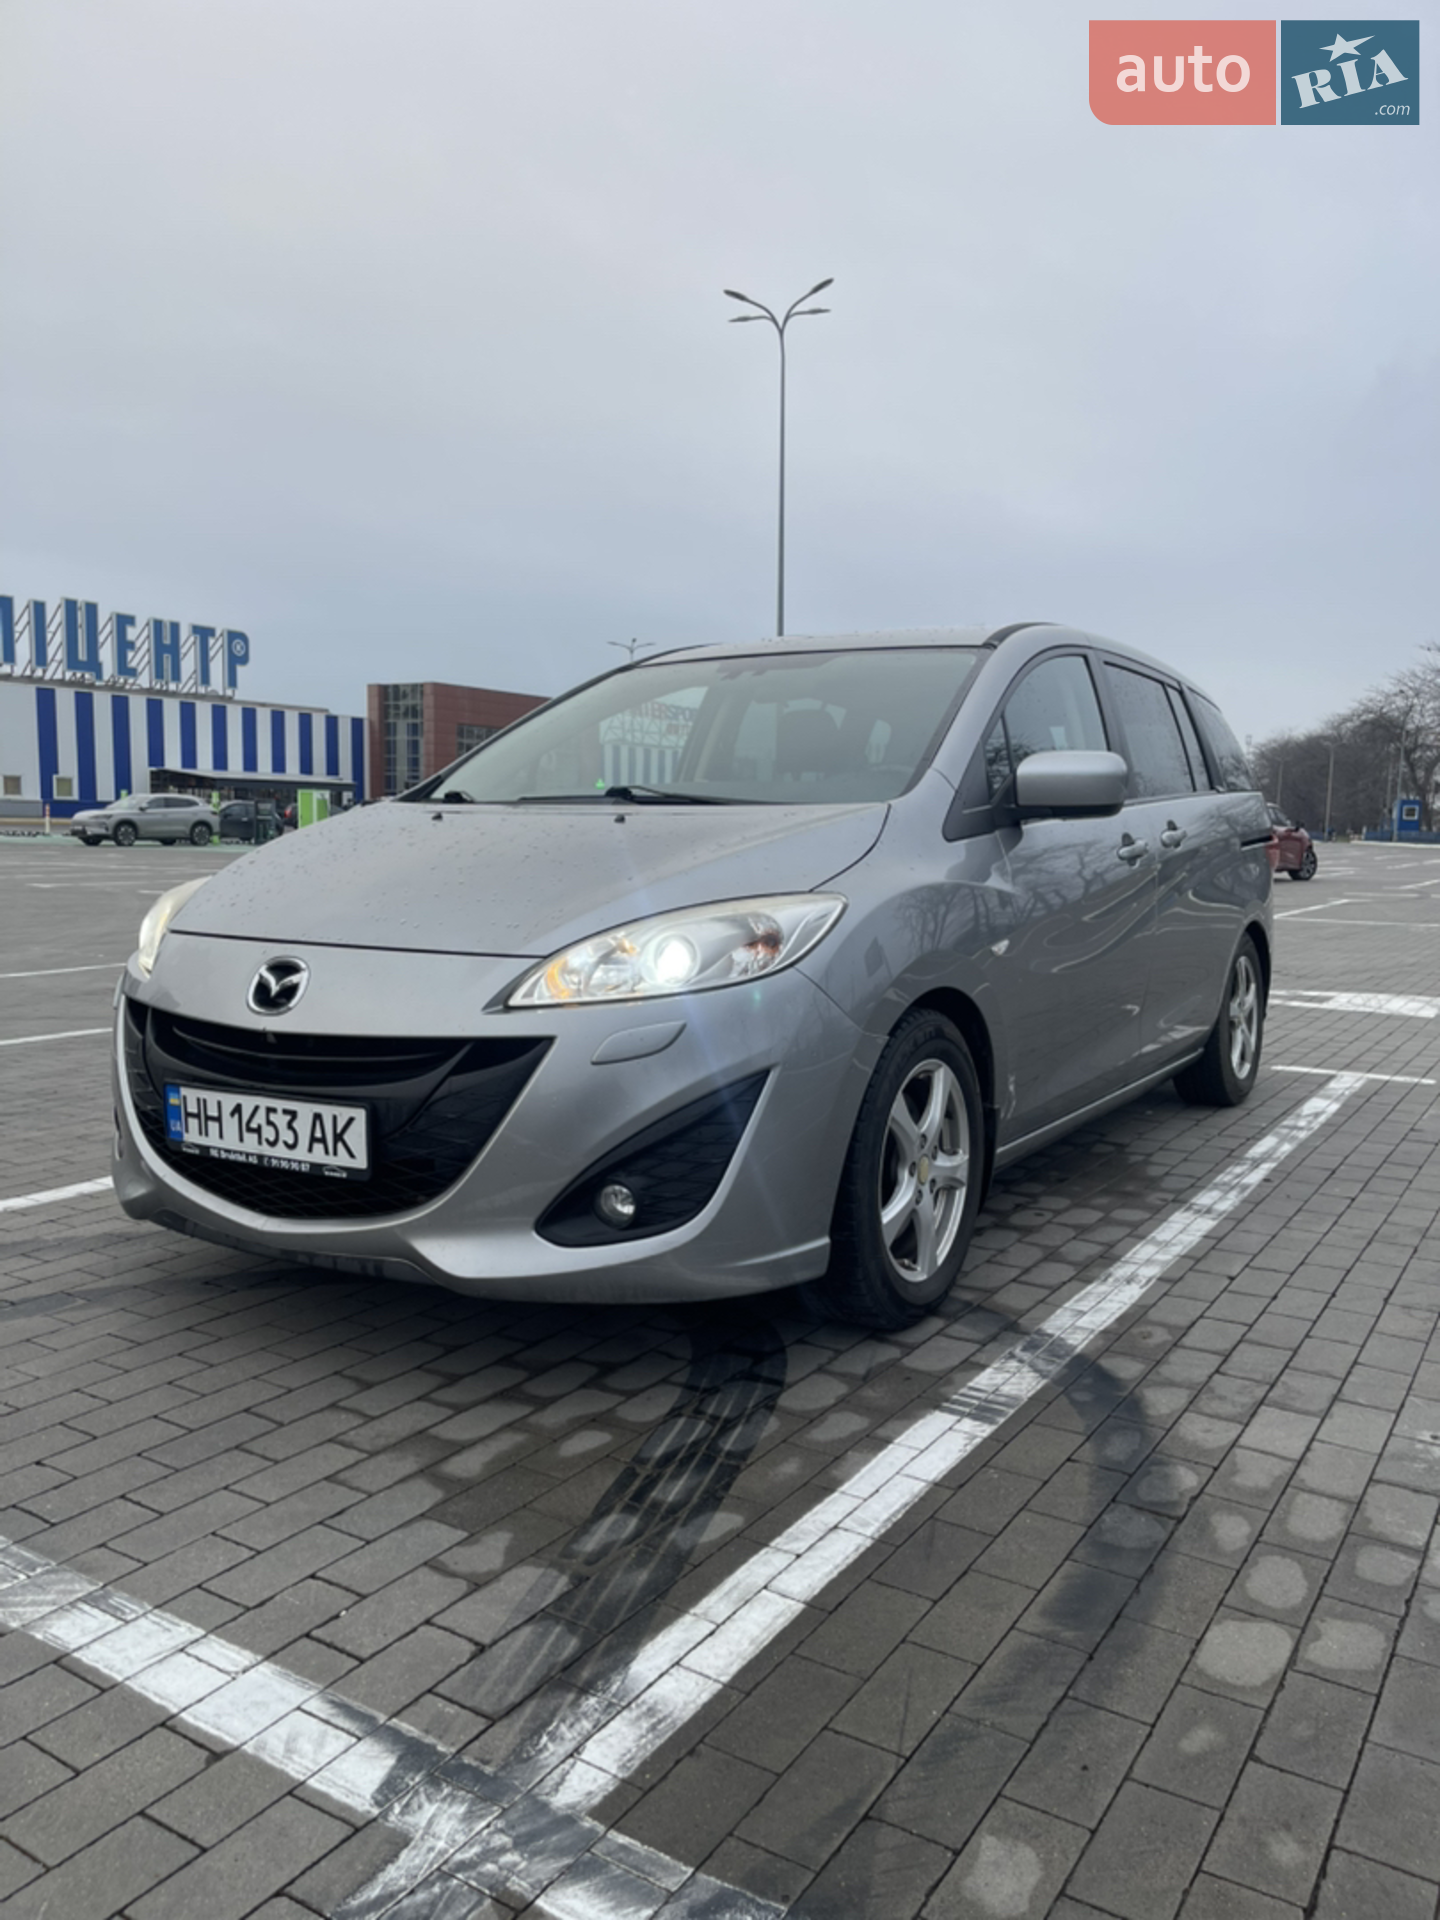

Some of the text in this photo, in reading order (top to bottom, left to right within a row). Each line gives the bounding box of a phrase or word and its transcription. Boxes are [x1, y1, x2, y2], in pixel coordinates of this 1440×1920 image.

[182, 1094, 357, 1160] HH 1453 AK
